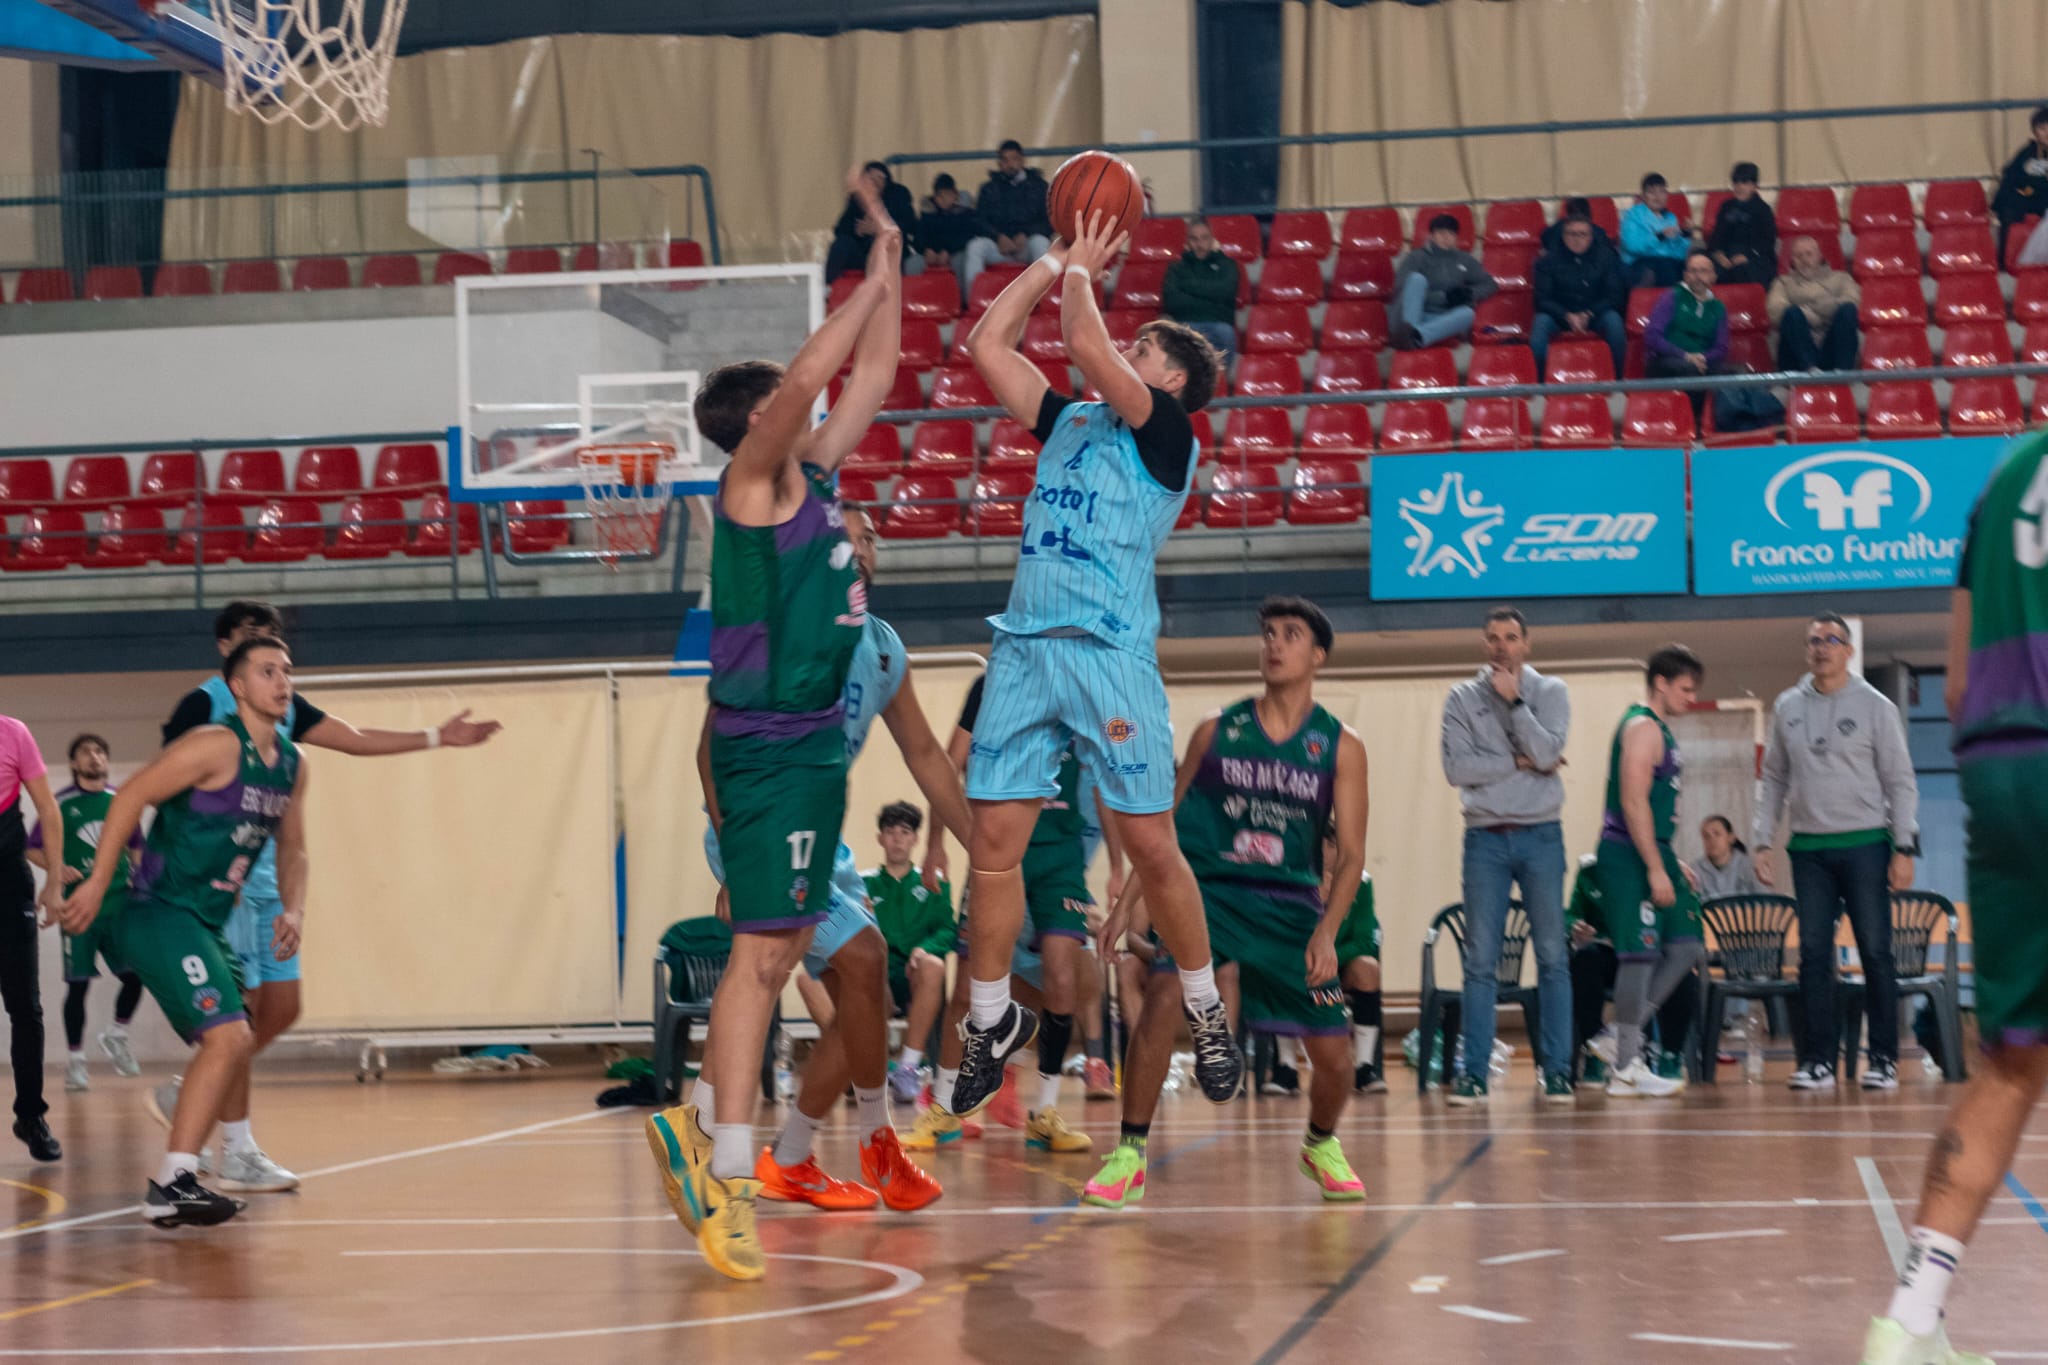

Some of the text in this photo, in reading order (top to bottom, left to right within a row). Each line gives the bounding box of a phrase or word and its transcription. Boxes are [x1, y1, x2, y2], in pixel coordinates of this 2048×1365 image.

[1731, 539, 1834, 567] Franco
[1843, 532, 1962, 562] Furnitur
[786, 829, 817, 870] 17
[181, 954, 210, 986] 9
